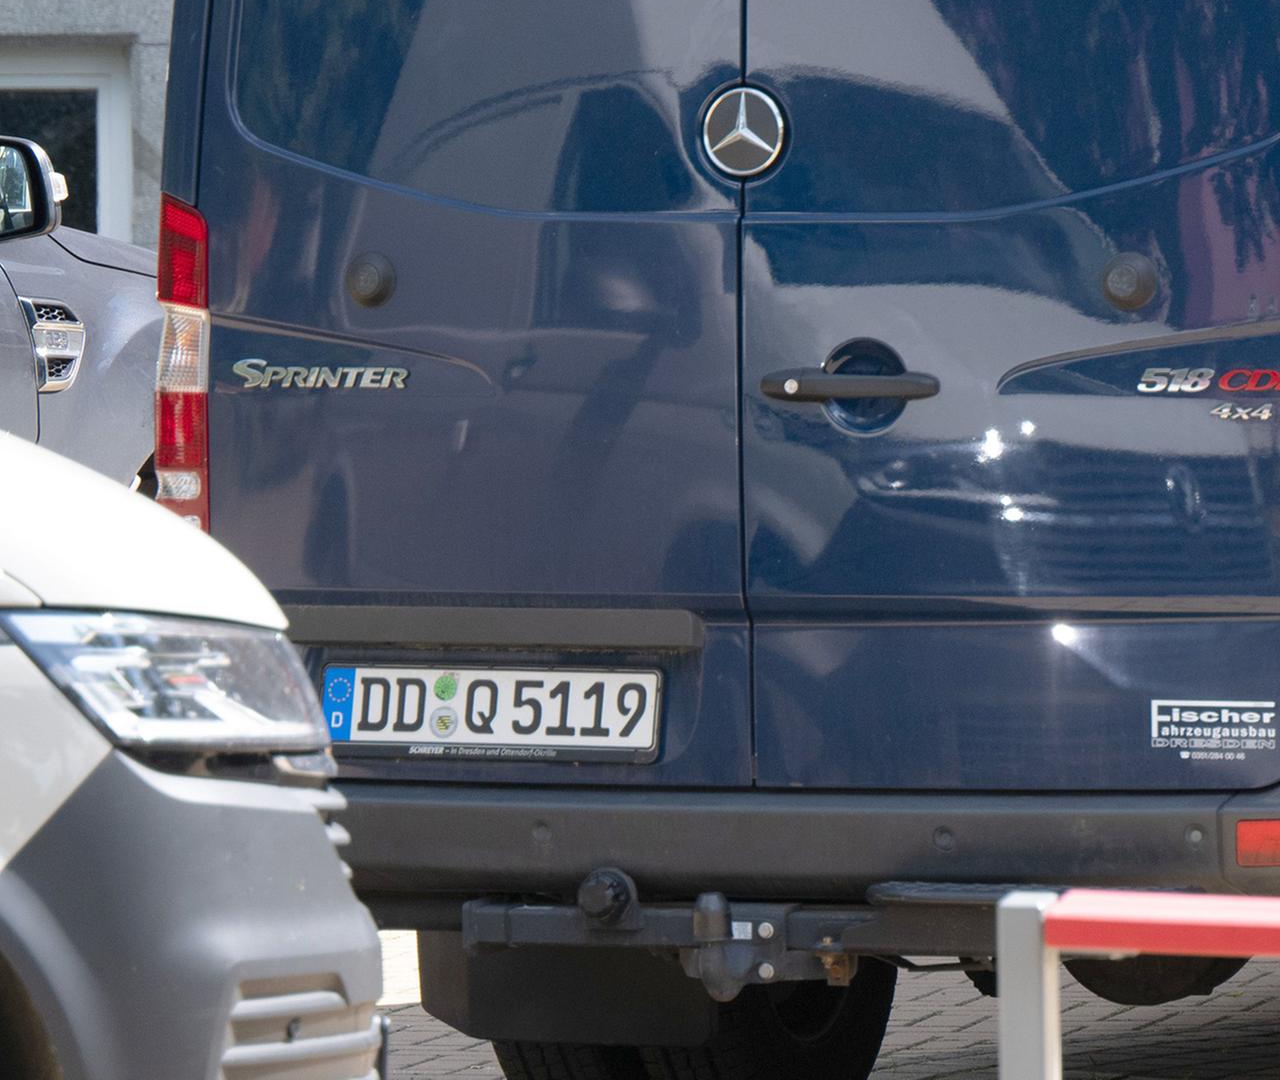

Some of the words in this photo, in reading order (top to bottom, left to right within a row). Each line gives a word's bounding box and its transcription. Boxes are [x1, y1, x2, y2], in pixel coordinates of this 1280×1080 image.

[232, 358, 409, 389] SPRINTER
[1137, 367, 1216, 393] 518
[1210, 403, 1273, 420] 4x4
[357, 677, 427, 732] DD
[464, 679, 499, 734] Q
[511, 680, 648, 737] 5119
[331, 711, 343, 728] D
[1151, 738, 1276, 749] DRESDEN
